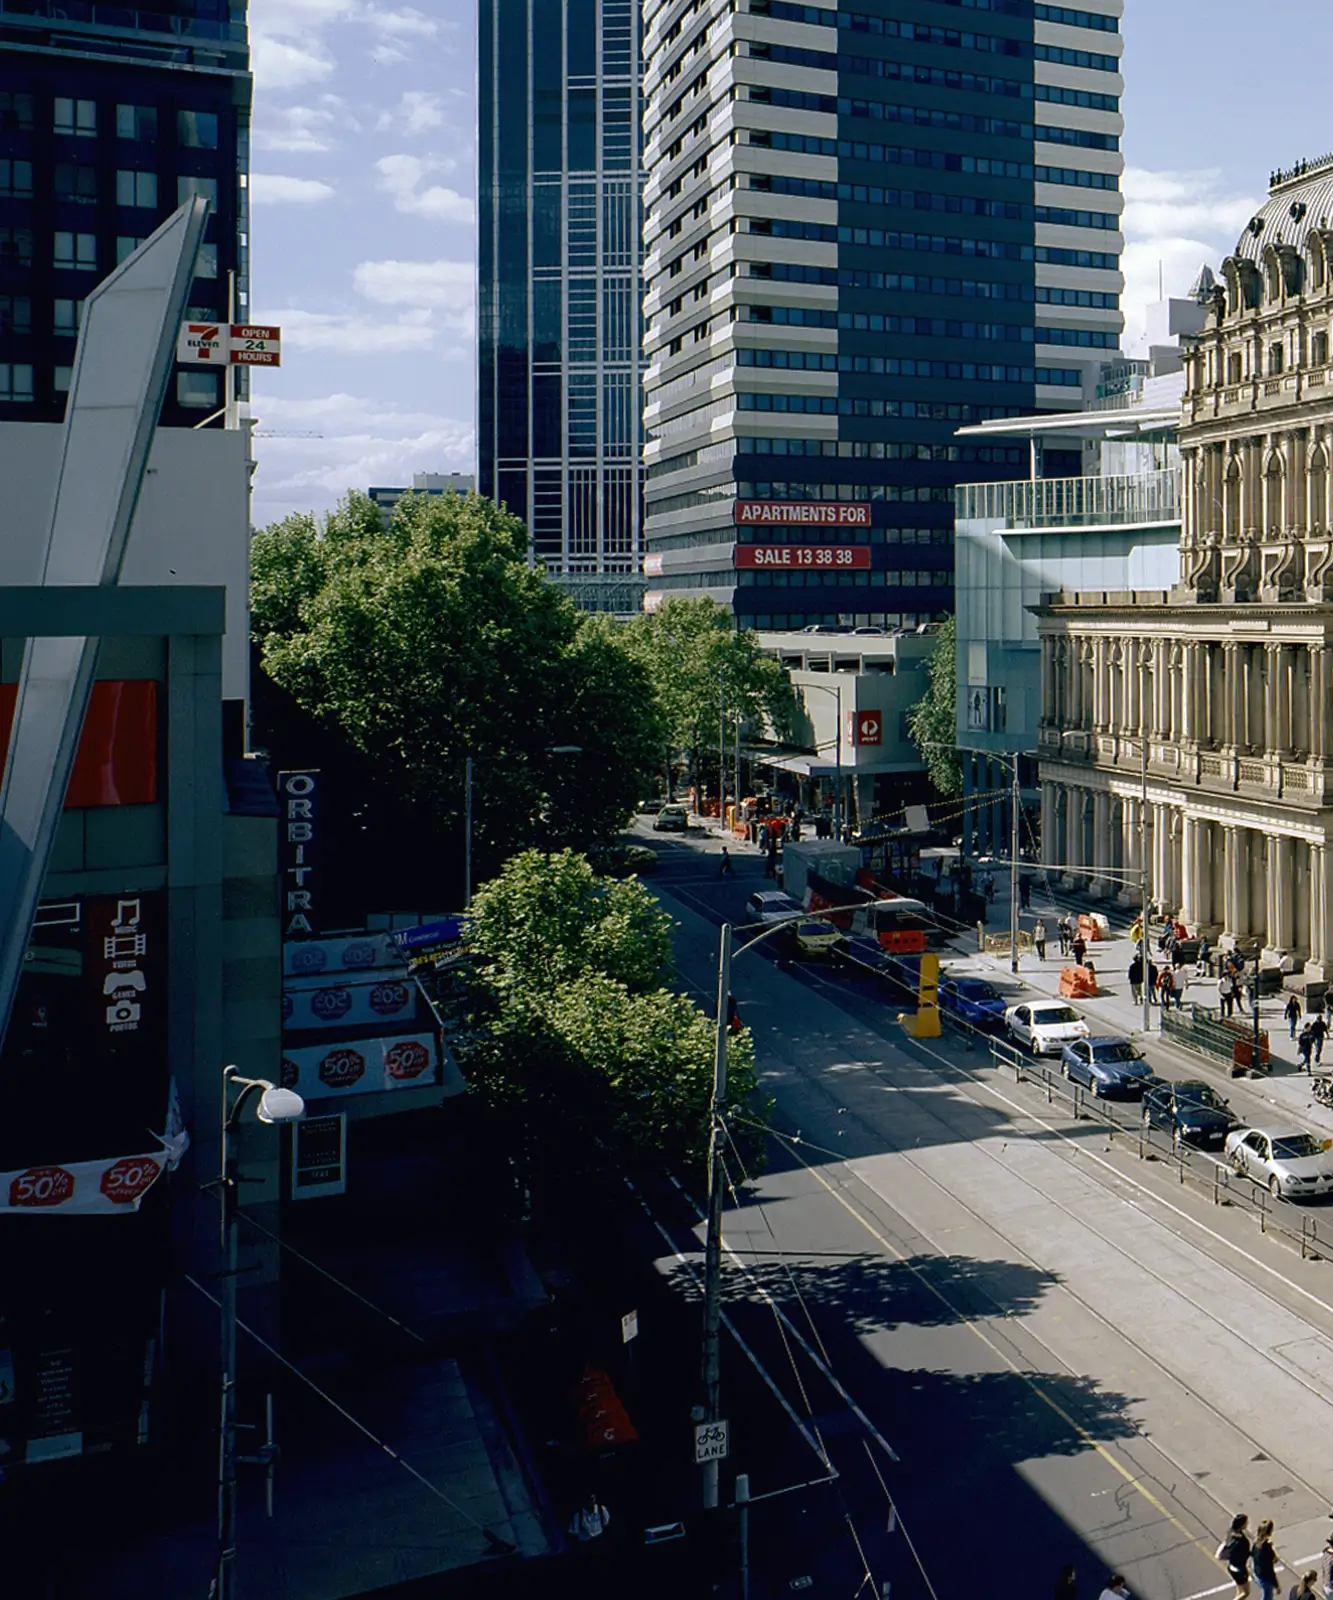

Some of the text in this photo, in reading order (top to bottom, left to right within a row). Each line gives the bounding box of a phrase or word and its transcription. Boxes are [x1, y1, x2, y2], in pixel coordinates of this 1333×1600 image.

[242, 328, 270, 338] OPEN
[188, 324, 219, 359] 7
[245, 340, 265, 350] 24
[238, 352, 272, 362] HOURS
[741, 505, 866, 522] APARTMENTS FOR
[754, 548, 853, 564] SALE 13 38 38
[105, 1163, 156, 1188] 50%
[16, 1170, 69, 1200] 50%
[698, 1443, 725, 1459] LANE
